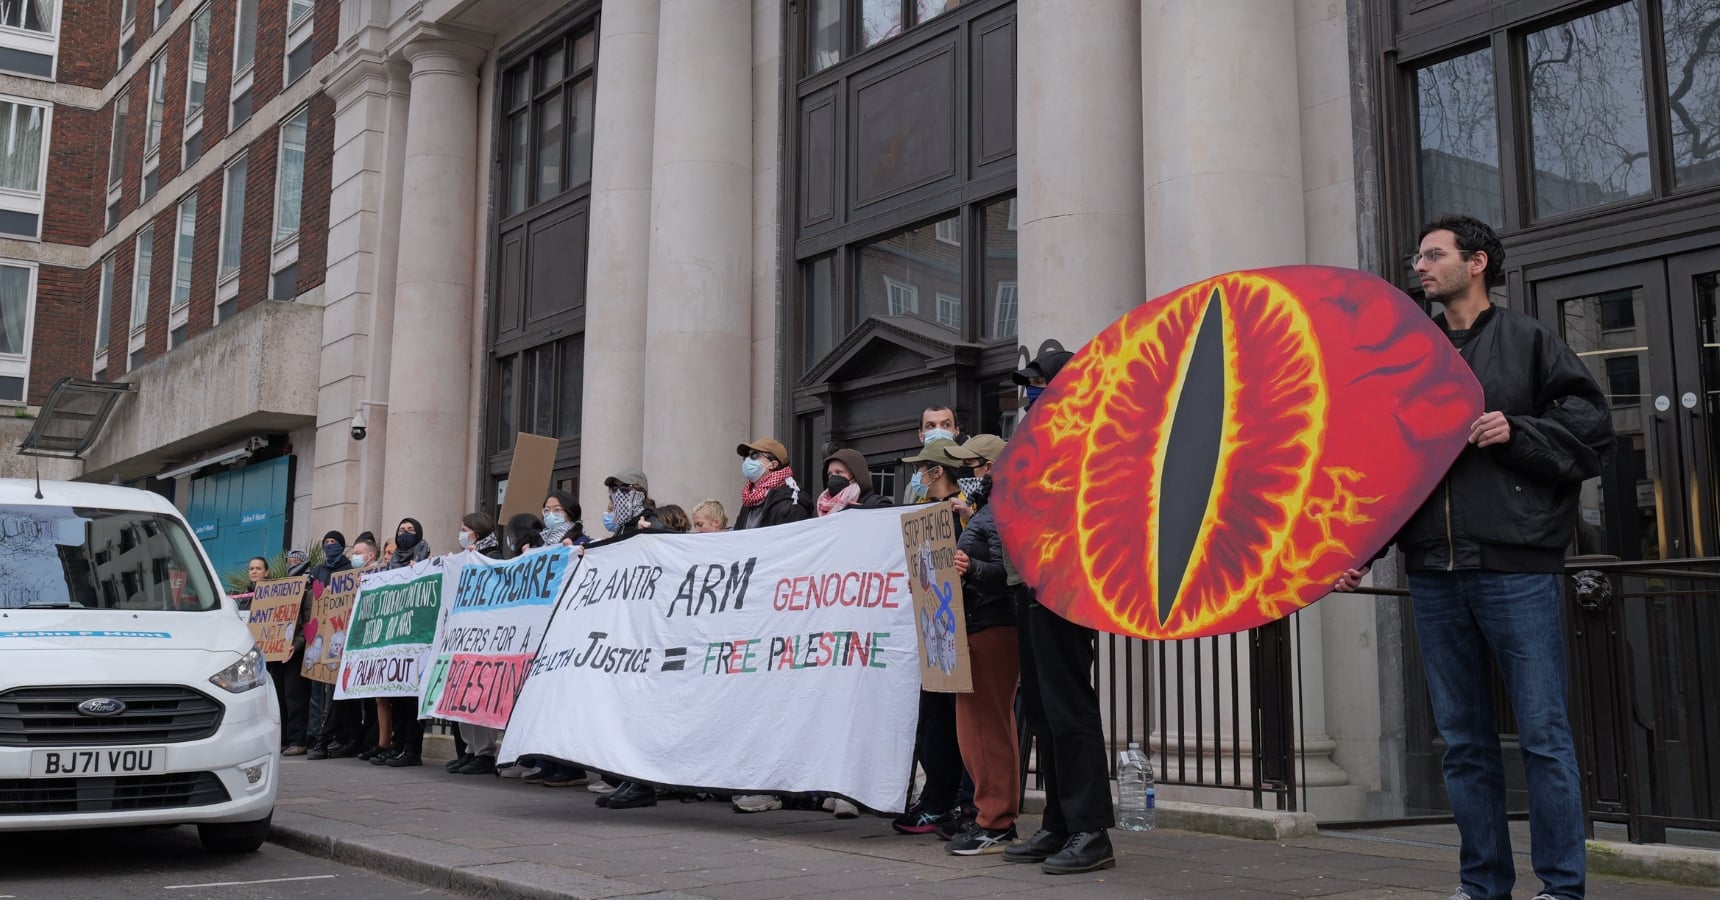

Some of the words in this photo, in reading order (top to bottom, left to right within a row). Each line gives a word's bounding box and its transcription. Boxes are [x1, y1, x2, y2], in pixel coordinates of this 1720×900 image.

[904, 519, 919, 549] STOP
[920, 512, 935, 542] THE
[935, 508, 951, 541] WEB
[254, 585, 270, 600] OUR
[270, 581, 302, 597] PATIENTS
[330, 572, 354, 595] NHS
[454, 554, 560, 609] HEALTHCARE
[566, 565, 662, 611] PALANTIR
[666, 557, 757, 617] ARM
[773, 571, 904, 612] GENOCIDE
[249, 607, 274, 623] WANT
[273, 602, 299, 623] HEALTH
[260, 623, 284, 640] NOT
[441, 627, 490, 654] WORKERS
[489, 625, 516, 652] FOR
[520, 626, 532, 653] A
[530, 642, 575, 677] HEALTH
[574, 631, 652, 674] JUSTICE
[703, 638, 761, 675] FREE
[767, 631, 890, 672] PALESTINE
[387, 658, 414, 683] OUT
[89, 701, 114, 712] Ford
[45, 751, 99, 774] BJ71
[108, 750, 153, 772] VOU
